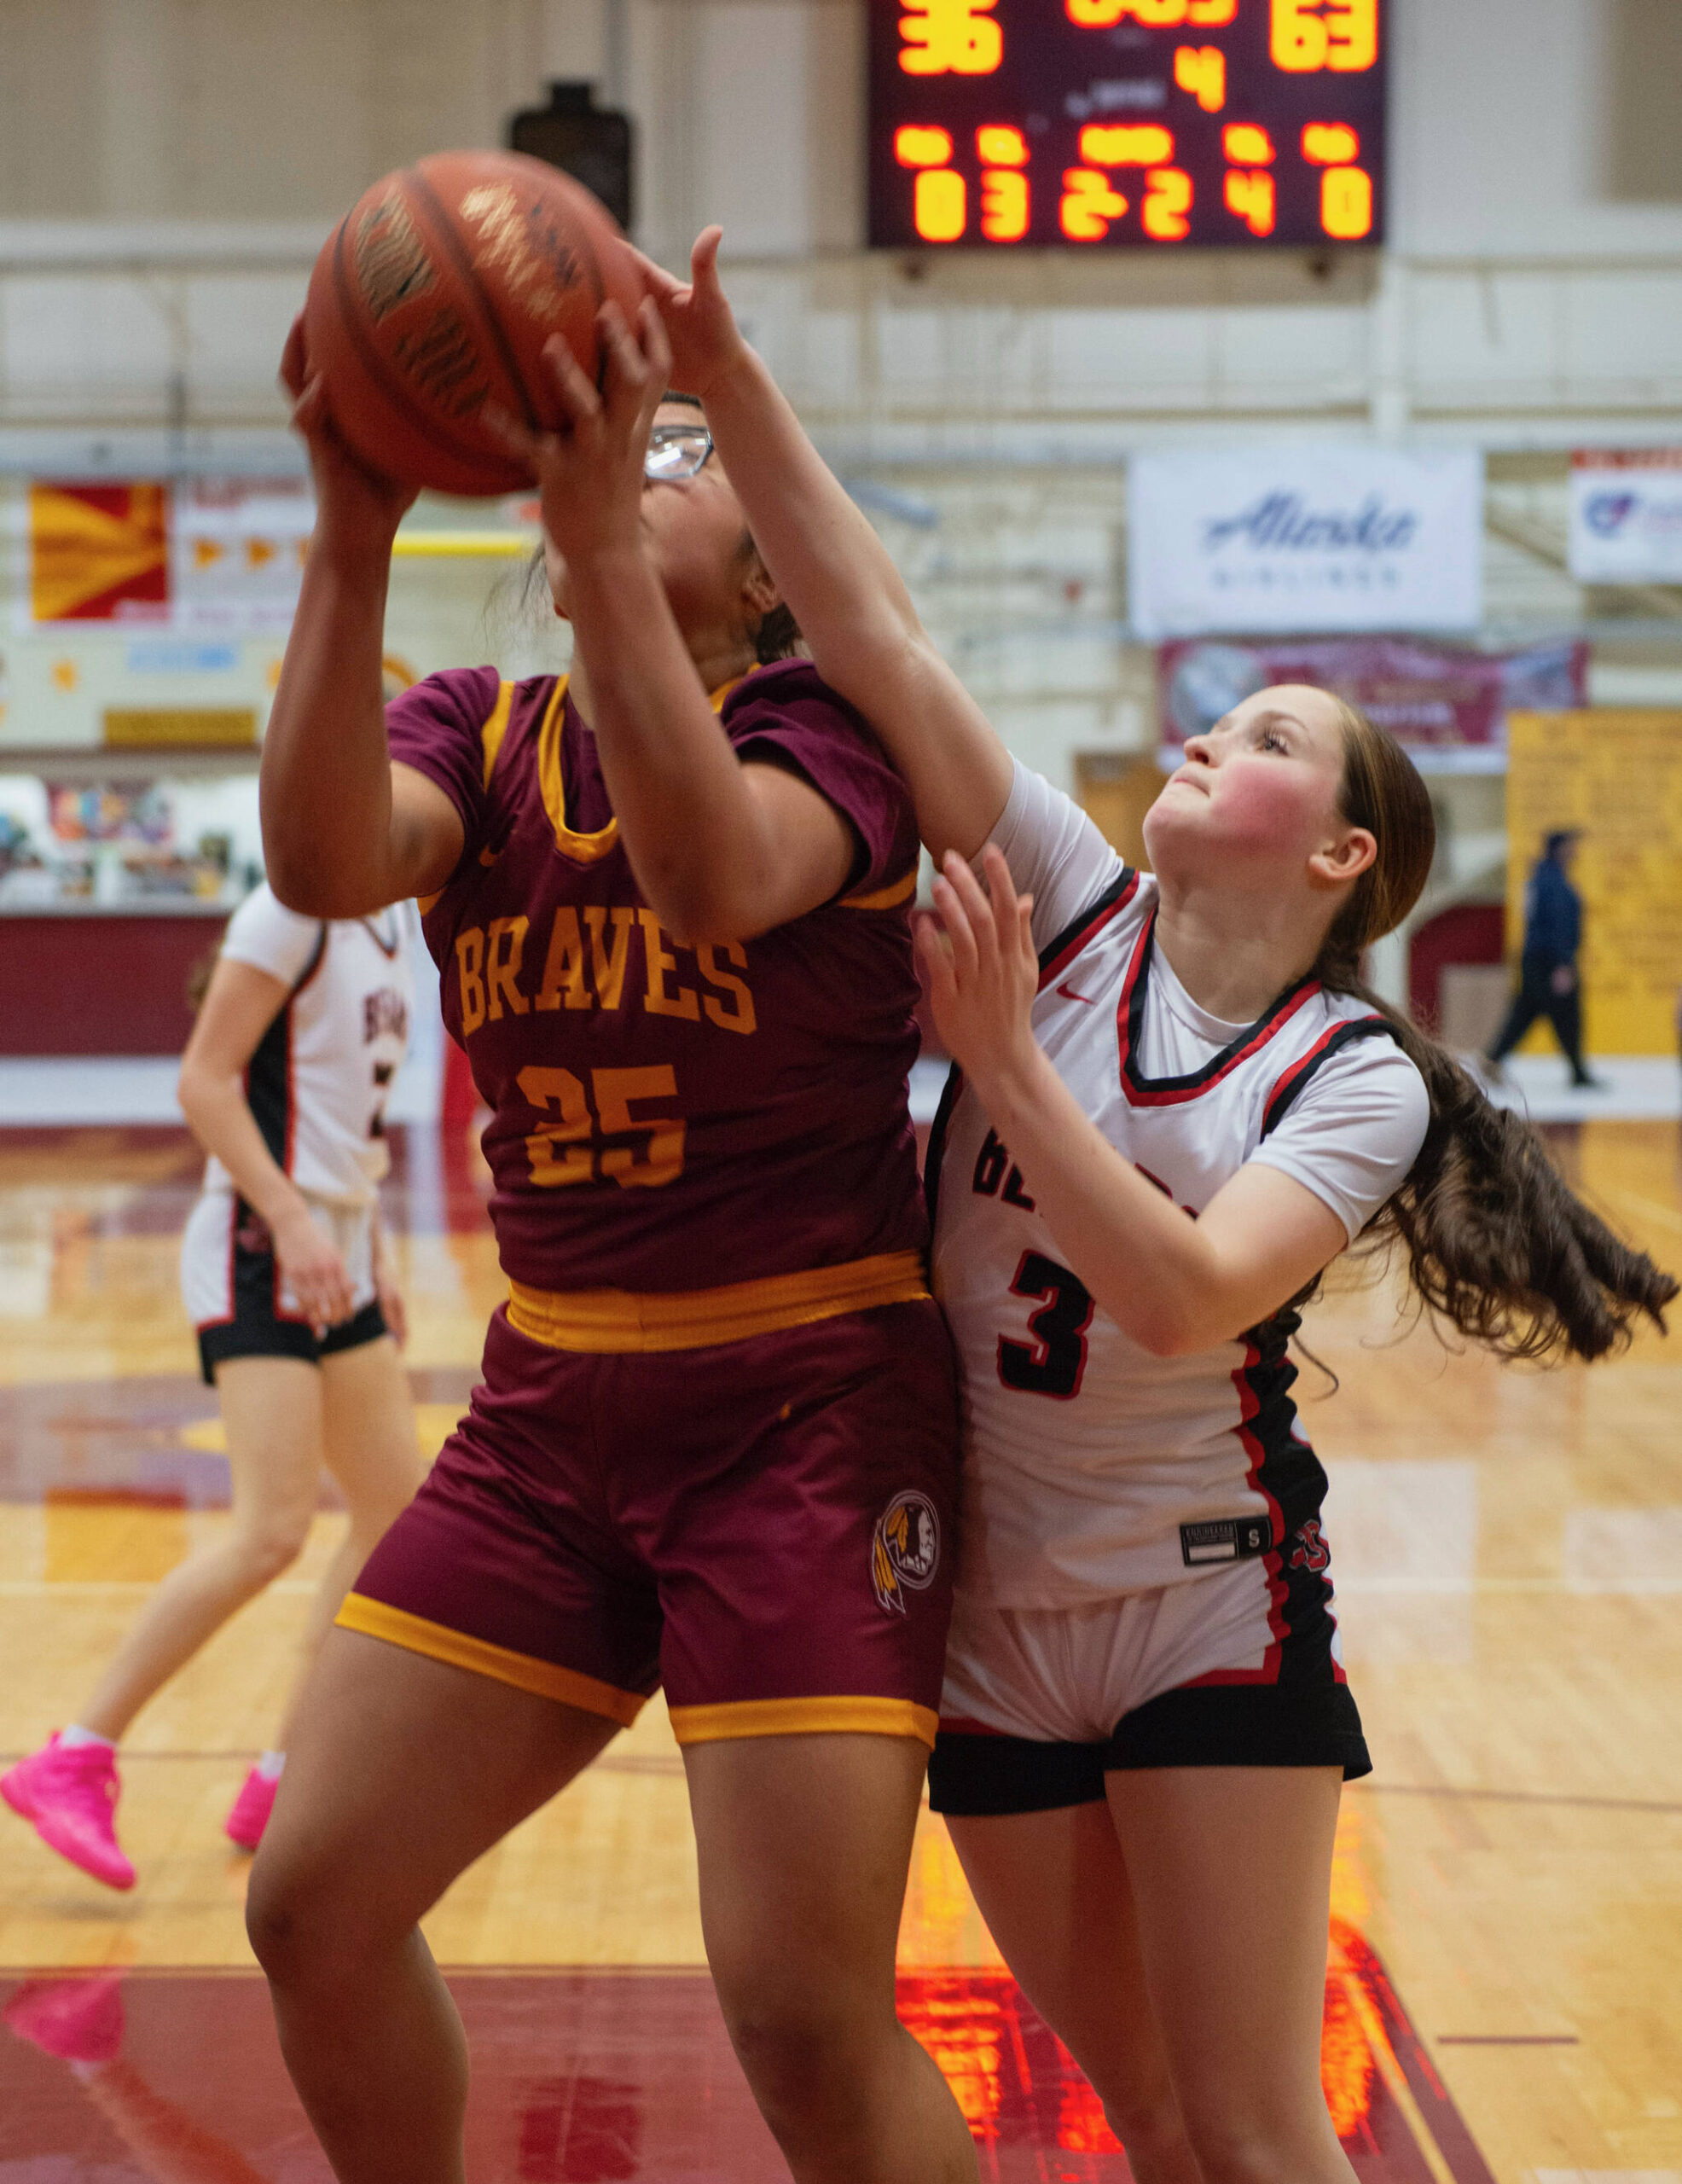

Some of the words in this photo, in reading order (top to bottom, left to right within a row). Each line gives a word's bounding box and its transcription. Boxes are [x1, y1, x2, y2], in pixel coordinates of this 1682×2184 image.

[898, 0, 1003, 75] 36
[1269, 0, 1378, 73] 63
[1174, 46, 1226, 113] 4
[455, 906, 757, 1037] BRAVES
[516, 1065, 687, 1188] 25
[996, 1249, 1096, 1401] 3
[1249, 1528, 1260, 1548] S
